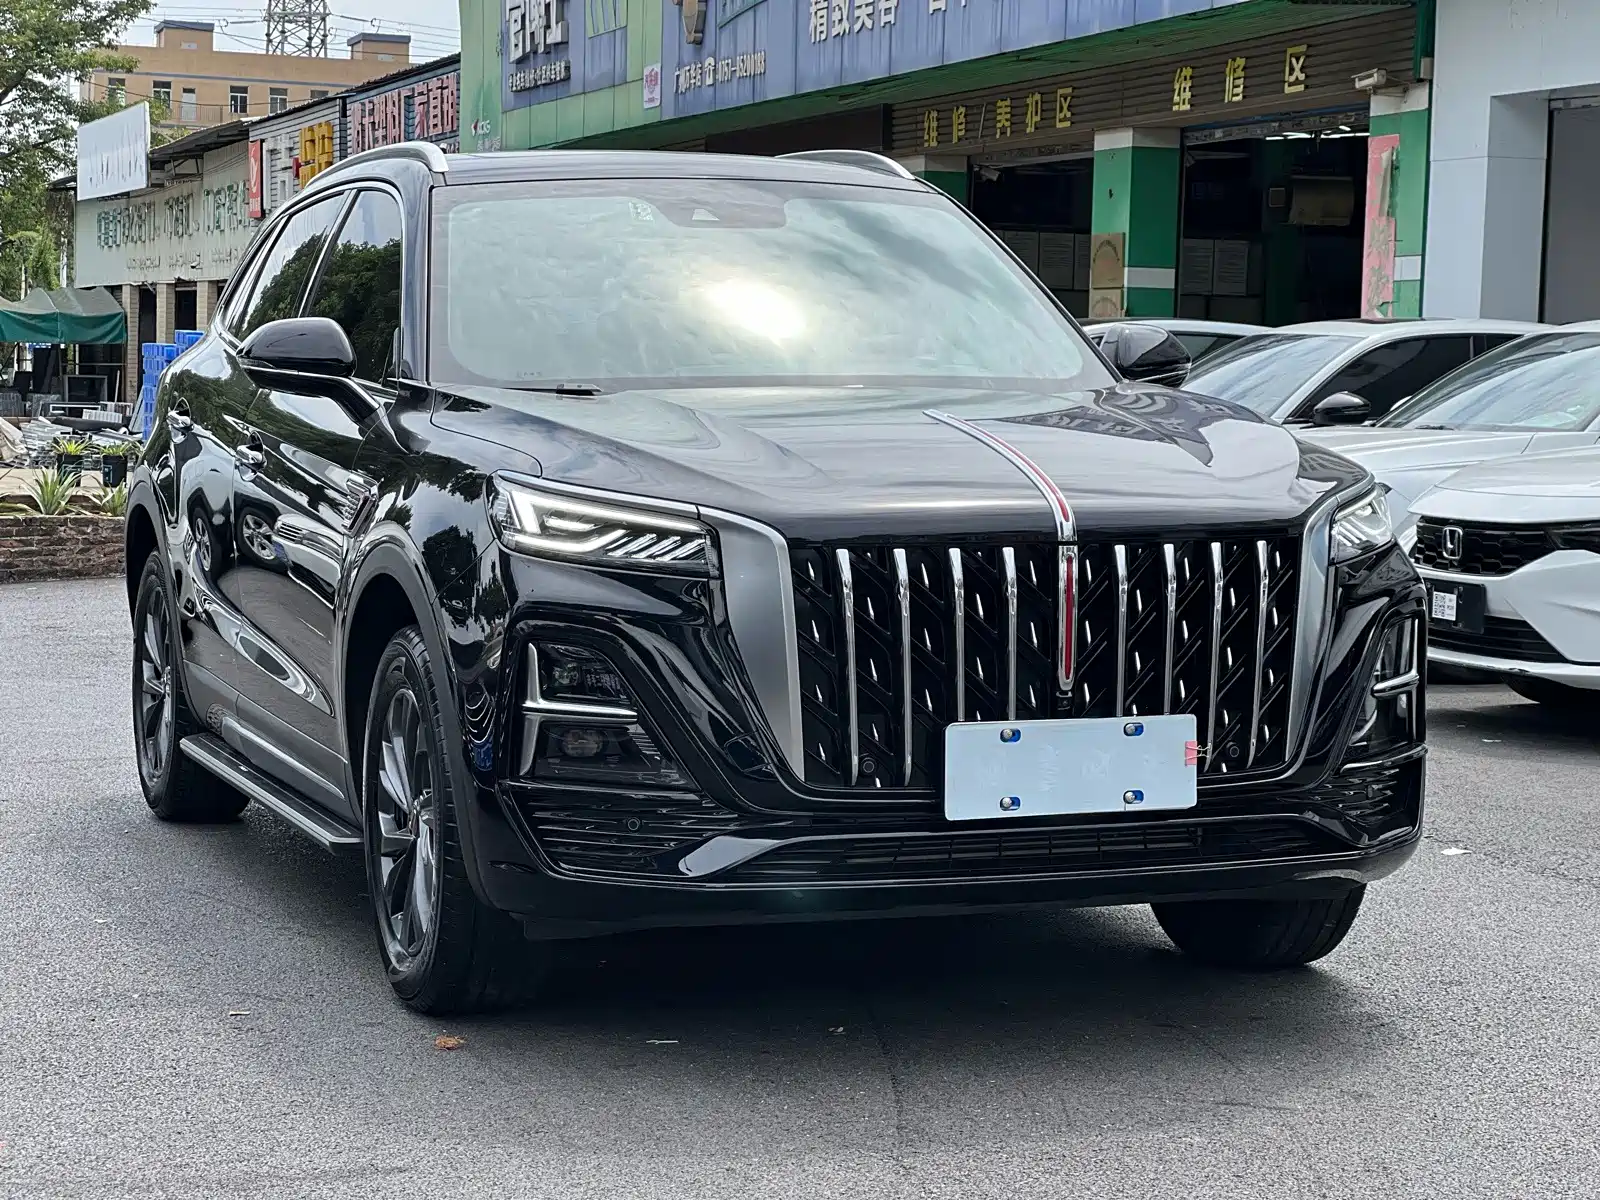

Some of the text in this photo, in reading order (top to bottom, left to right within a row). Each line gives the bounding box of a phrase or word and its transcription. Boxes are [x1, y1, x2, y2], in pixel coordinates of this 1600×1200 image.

[1172, 43, 1308, 112] 维修区
[924, 86, 1073, 148] 维修/养护区
